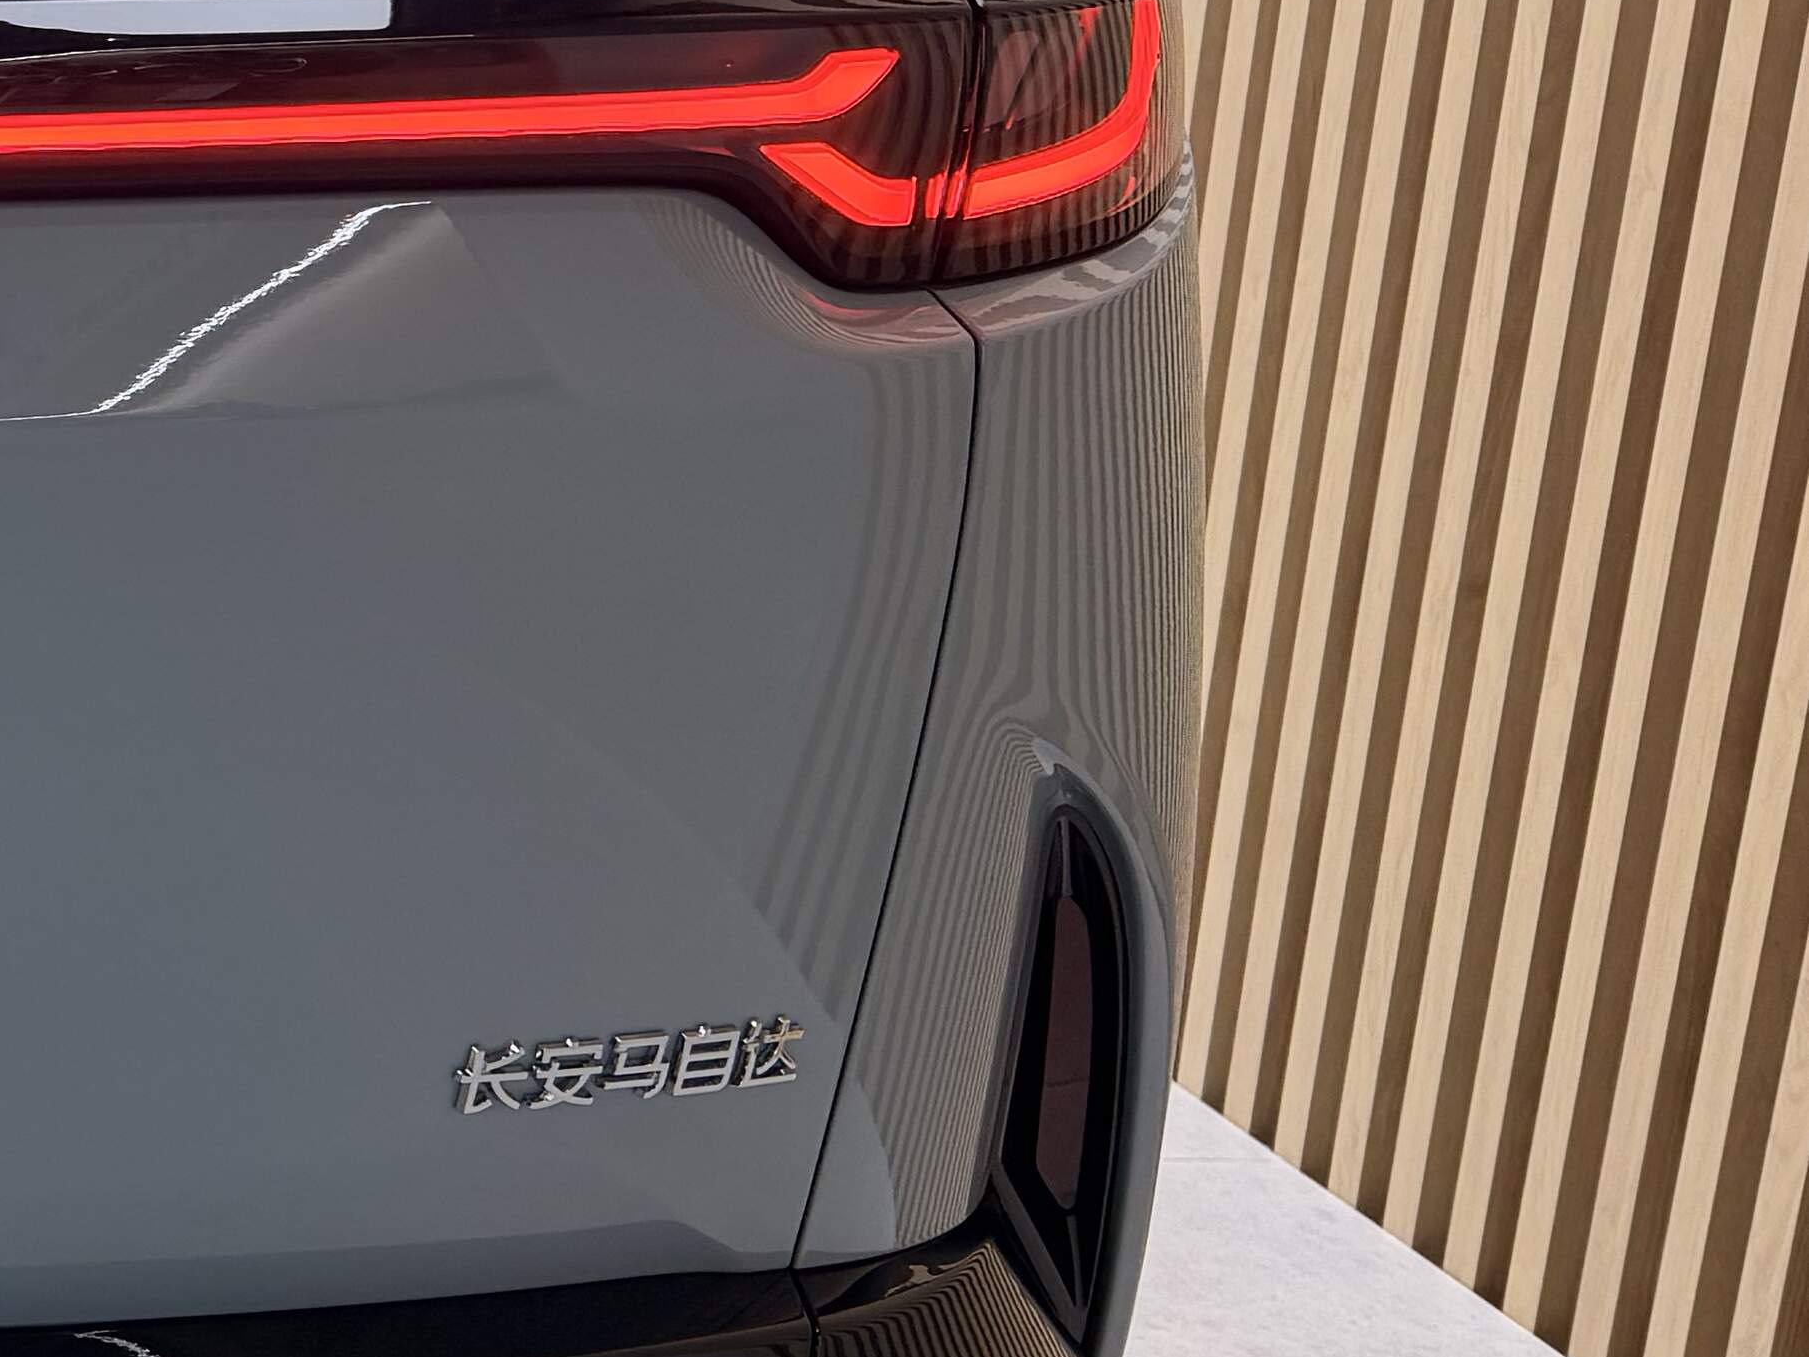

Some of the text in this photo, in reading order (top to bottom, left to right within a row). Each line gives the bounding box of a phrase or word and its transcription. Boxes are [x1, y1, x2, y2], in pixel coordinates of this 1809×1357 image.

[453, 1015, 805, 1115] 长安马自达
